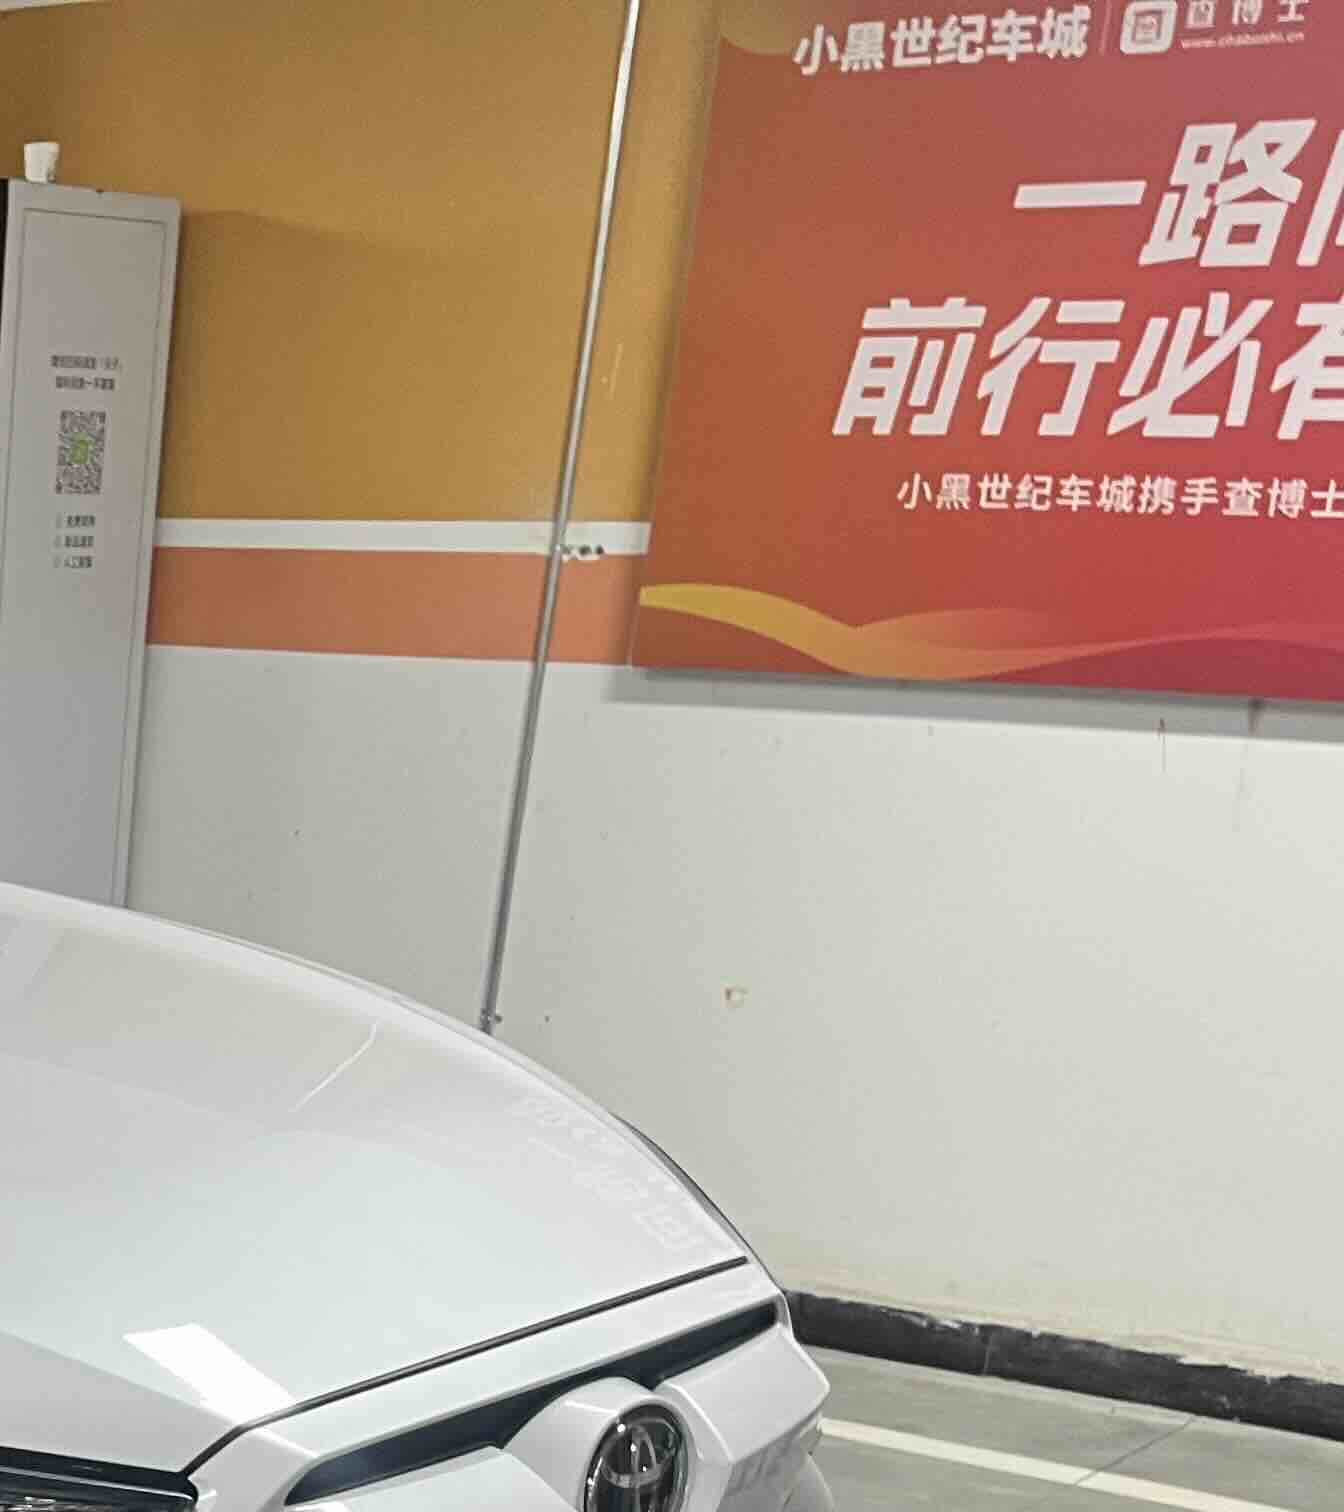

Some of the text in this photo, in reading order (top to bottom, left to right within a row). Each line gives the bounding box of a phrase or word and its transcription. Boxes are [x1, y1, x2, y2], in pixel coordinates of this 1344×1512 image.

[793, 5, 1091, 76] 小黑世纪车城
[896, 471, 1344, 520] 小黑世纪车城携手查博士
